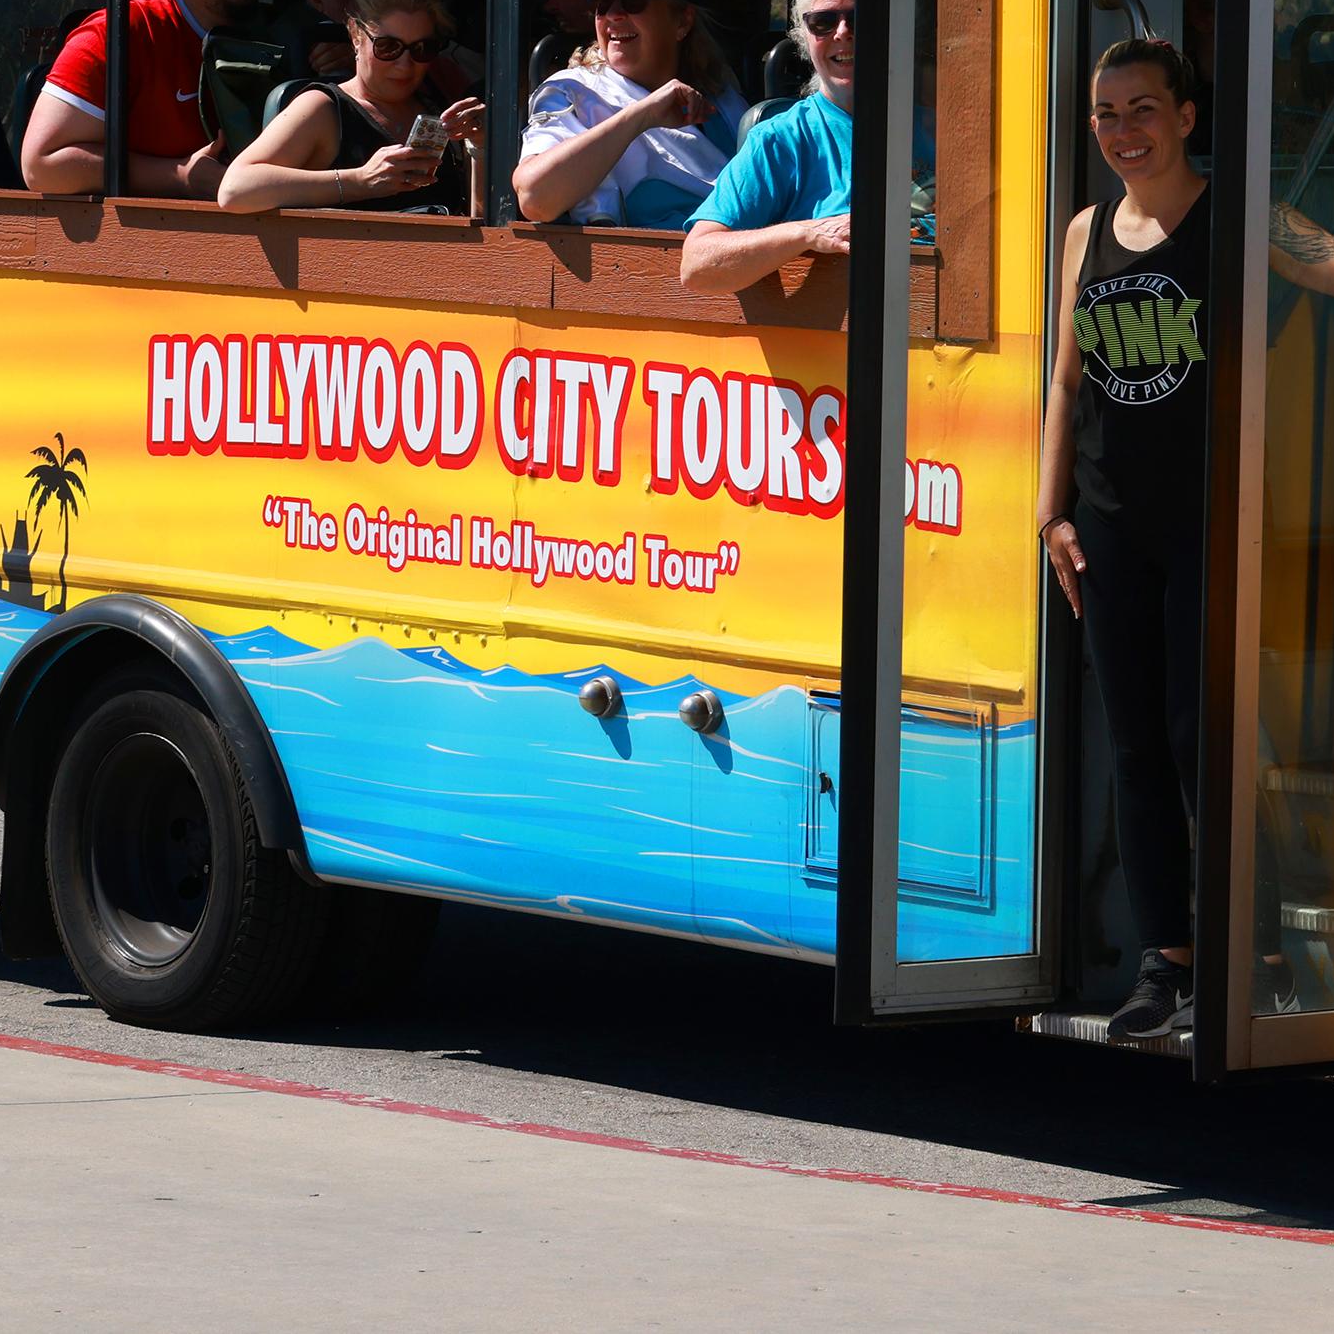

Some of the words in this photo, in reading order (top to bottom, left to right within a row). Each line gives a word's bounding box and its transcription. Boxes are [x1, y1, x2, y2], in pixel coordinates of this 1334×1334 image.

[1087, 279, 1128, 298] LOVE
[1135, 276, 1168, 292] PINK
[1072, 298, 1207, 373] PINK
[150, 339, 480, 459] HOLLYWOOD
[498, 352, 630, 474] CITY
[1104, 375, 1136, 400] LOVE
[1143, 370, 1178, 399] PINK
[346, 506, 461, 569] Original
[471, 519, 635, 584] Hollywood
